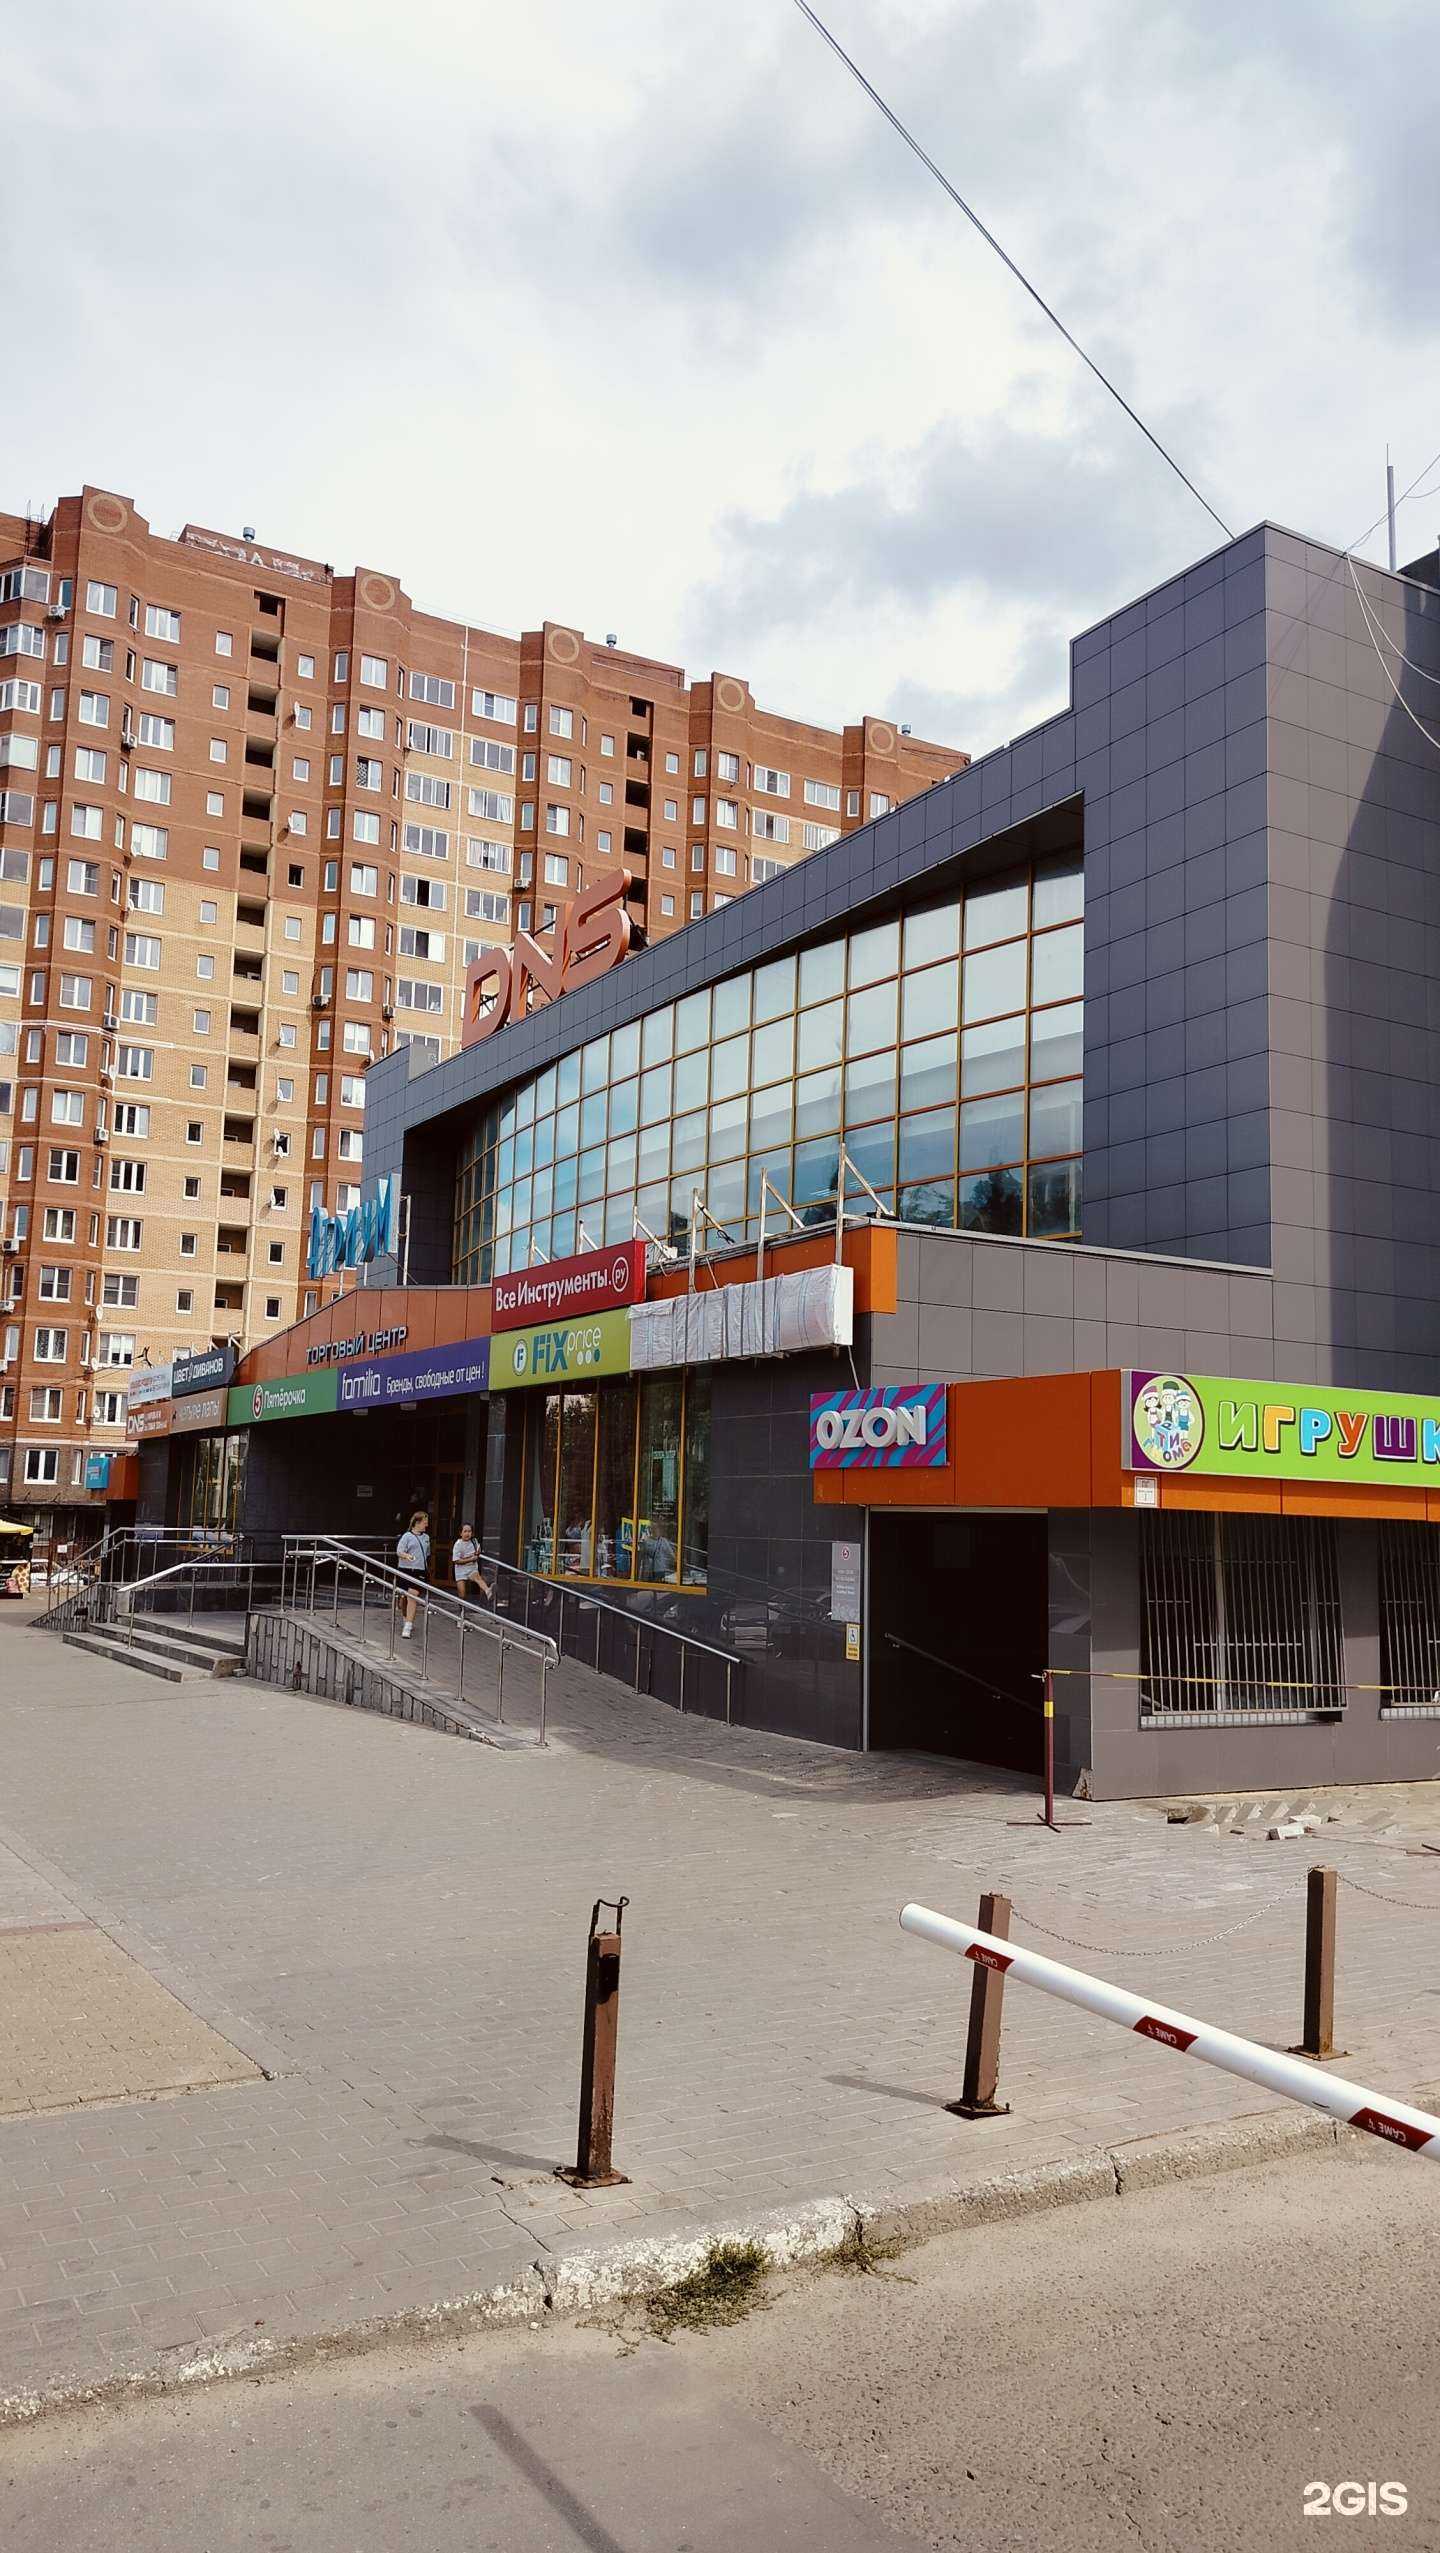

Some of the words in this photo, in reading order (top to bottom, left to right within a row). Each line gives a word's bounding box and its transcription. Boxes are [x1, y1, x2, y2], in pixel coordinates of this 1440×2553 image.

[461, 868, 631, 1050] DNS
[306, 1332, 365, 1365] ТОРГОВЫЙ
[366, 1326, 408, 1352] ЦЕНТР
[566, 1327, 601, 1356] price
[341, 1367, 381, 1401] familia
[414, 1368, 454, 1390] свободные
[455, 1368, 466, 1382] от
[264, 1387, 306, 1411] Пятёрочка
[127, 1414, 145, 1435] DNS
[816, 1405, 926, 1450] OZON
[1377, 2121, 1407, 2142] CAME
